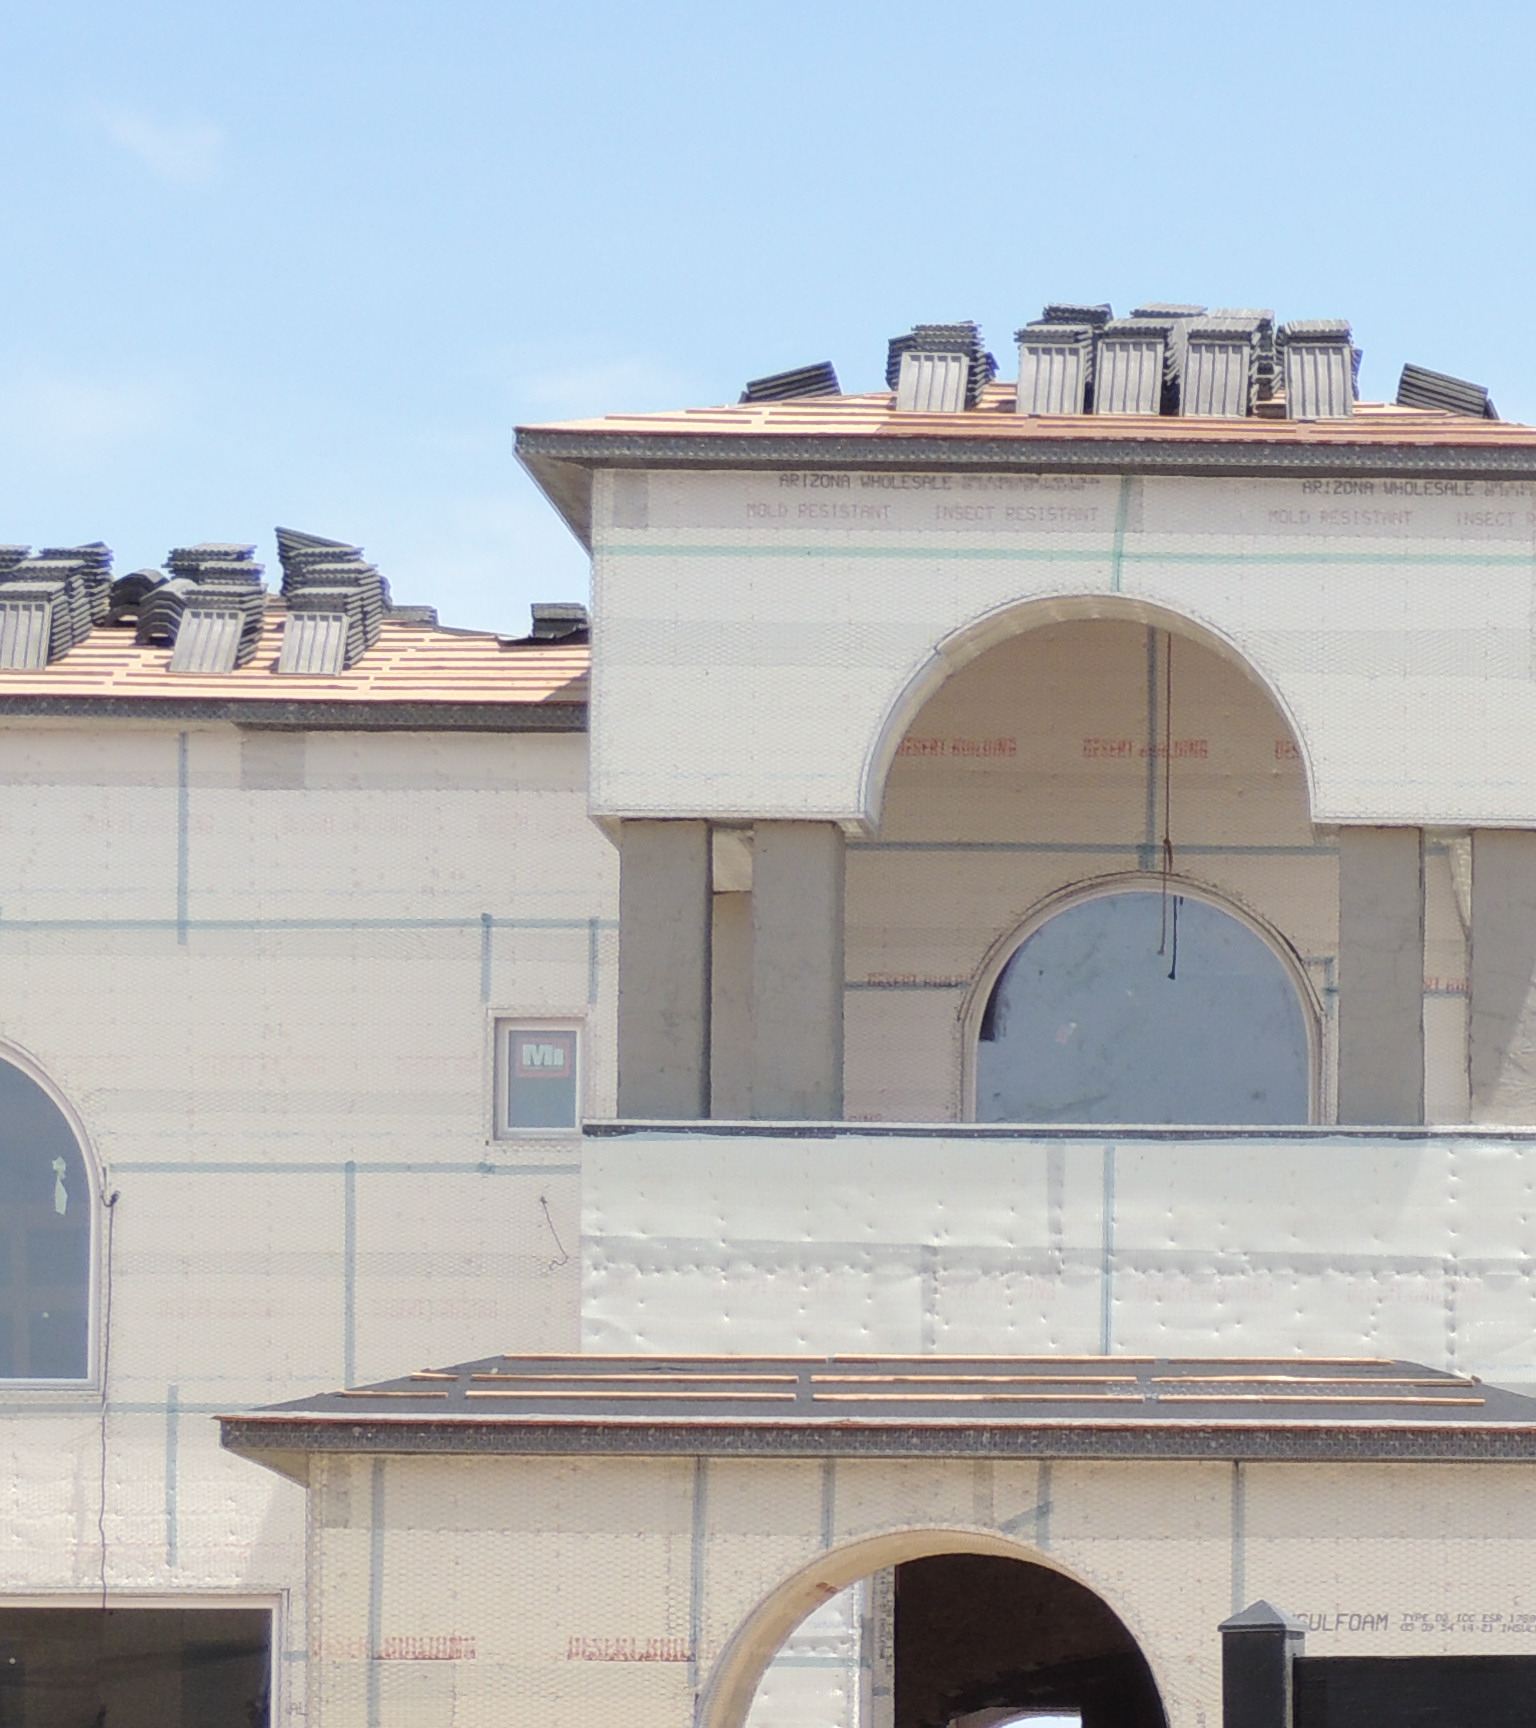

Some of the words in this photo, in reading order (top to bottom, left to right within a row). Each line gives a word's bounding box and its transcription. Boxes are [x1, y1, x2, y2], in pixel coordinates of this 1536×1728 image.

[780, 474, 851, 490] ARIZONA
[860, 475, 952, 491] WHOLESALE
[1302, 481, 1375, 496] ARIZONA
[1383, 482, 1475, 497] WHOLESALE
[746, 503, 788, 519] MOLD
[798, 504, 892, 520] RESISTANT
[934, 505, 995, 520] INSECT
[1006, 506, 1099, 521] RESISTANT
[1268, 509, 1311, 525] MOLD
[1319, 510, 1414, 525] RESISTANT
[1456, 511, 1514, 526] INSECT
